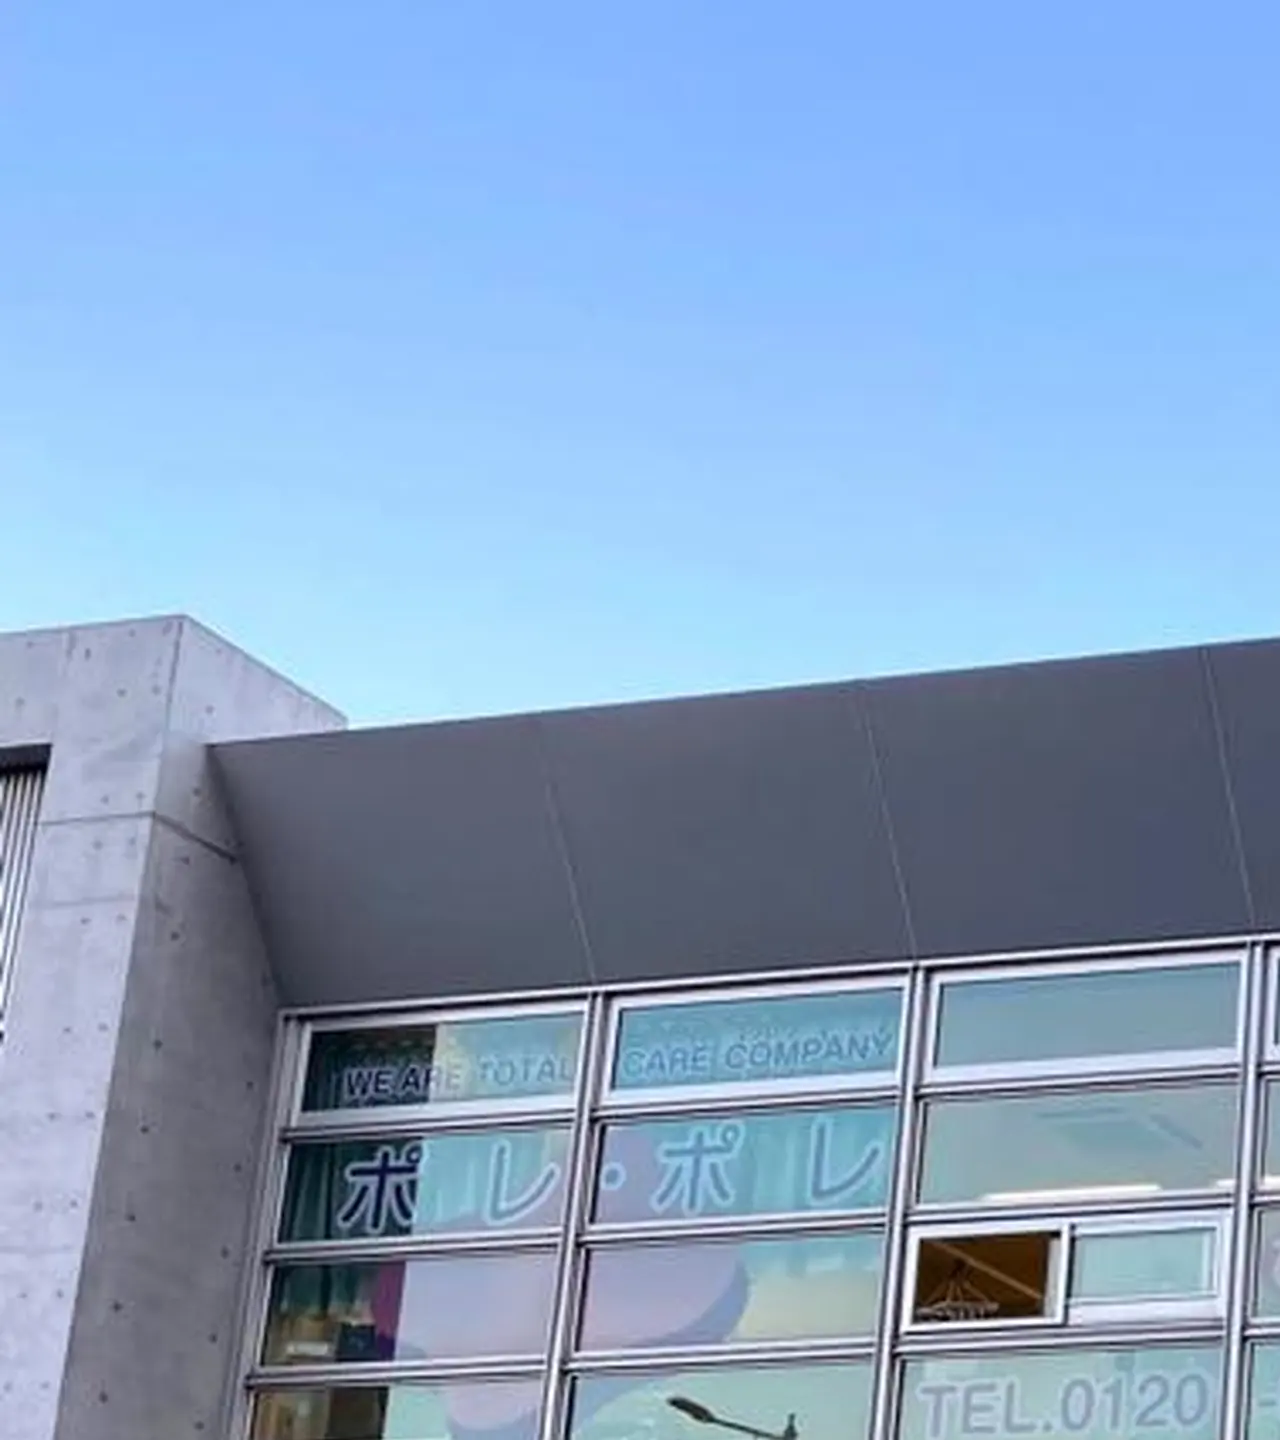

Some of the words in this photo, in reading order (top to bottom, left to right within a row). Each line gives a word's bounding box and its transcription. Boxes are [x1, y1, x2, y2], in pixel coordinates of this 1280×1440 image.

[345, 1067, 395, 1099] WE
[401, 1064, 462, 1096] ARE
[477, 1056, 577, 1089] TOTAL
[621, 1046, 708, 1078] CARE
[724, 1029, 895, 1073] COMPANY
